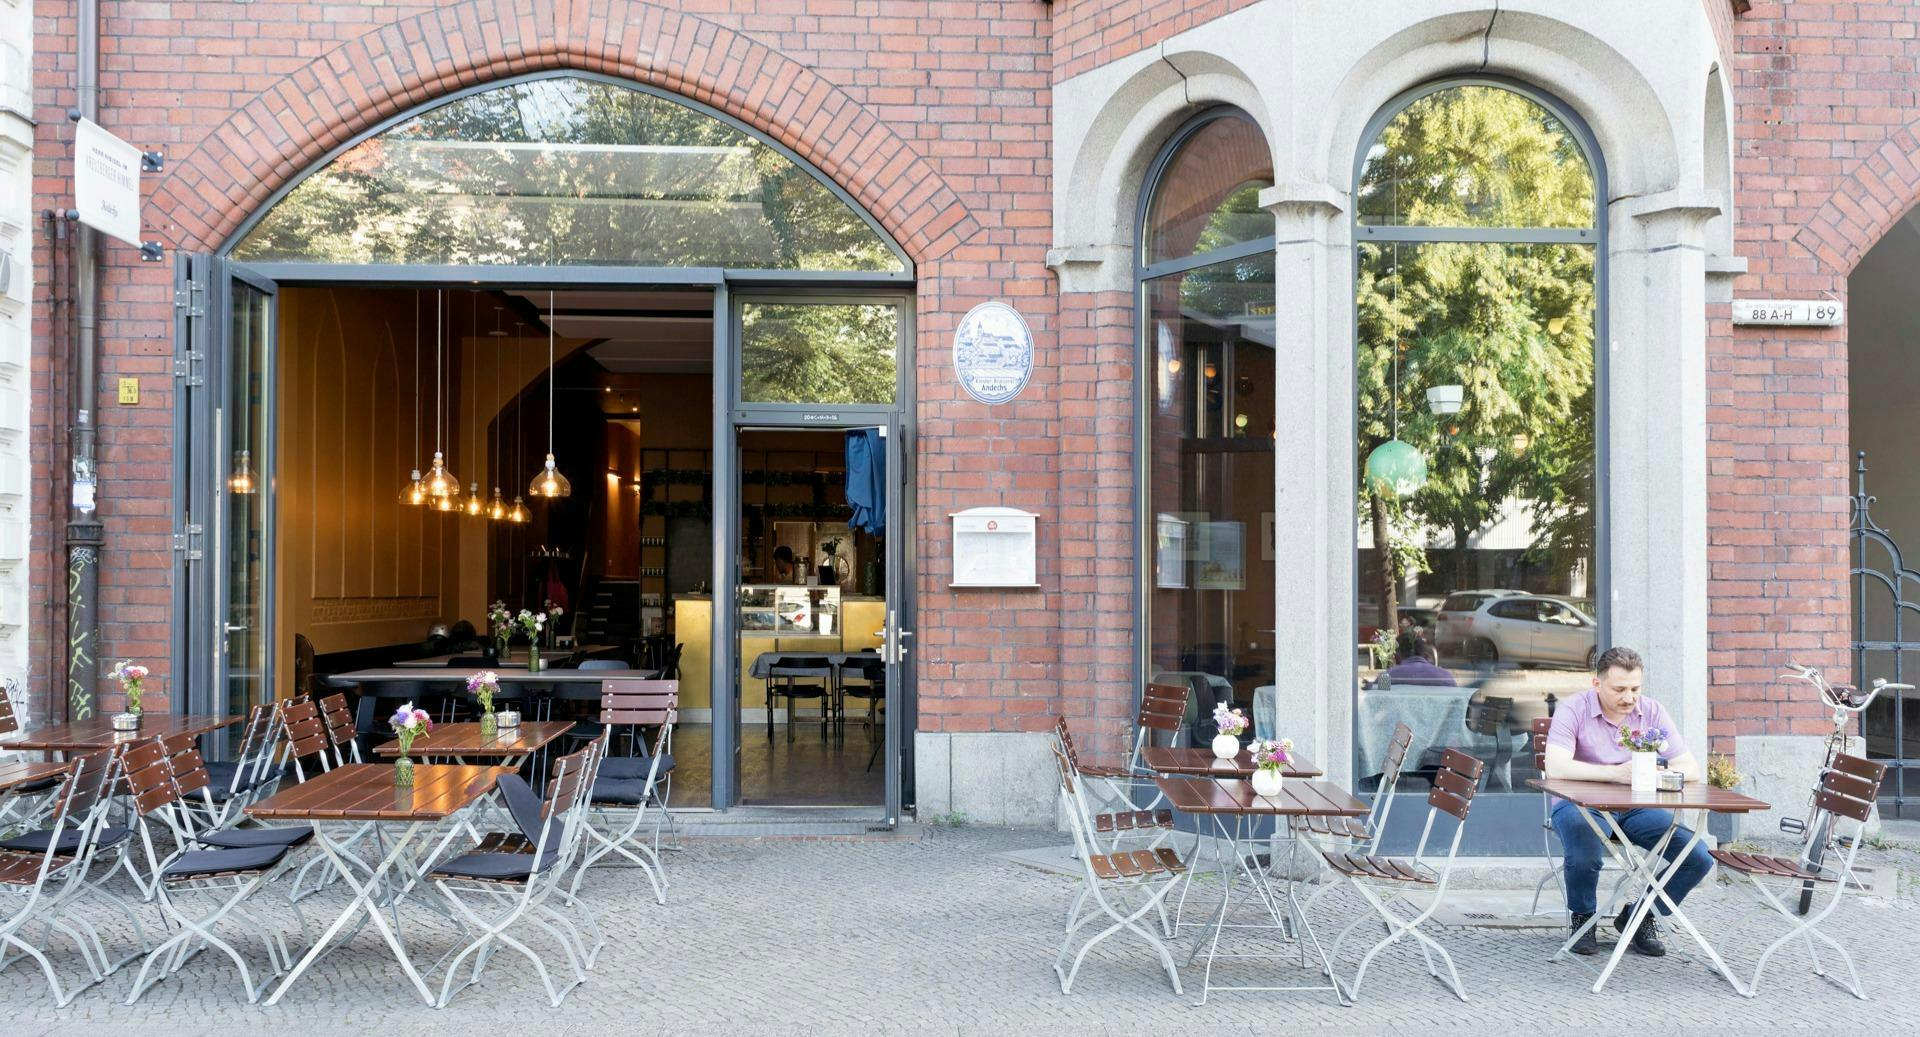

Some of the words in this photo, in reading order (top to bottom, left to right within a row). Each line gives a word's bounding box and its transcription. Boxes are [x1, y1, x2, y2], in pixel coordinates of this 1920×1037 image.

[1752, 309, 1767, 320] 88
[1770, 309, 1793, 320] A-H
[1815, 305, 1837, 320] 89
